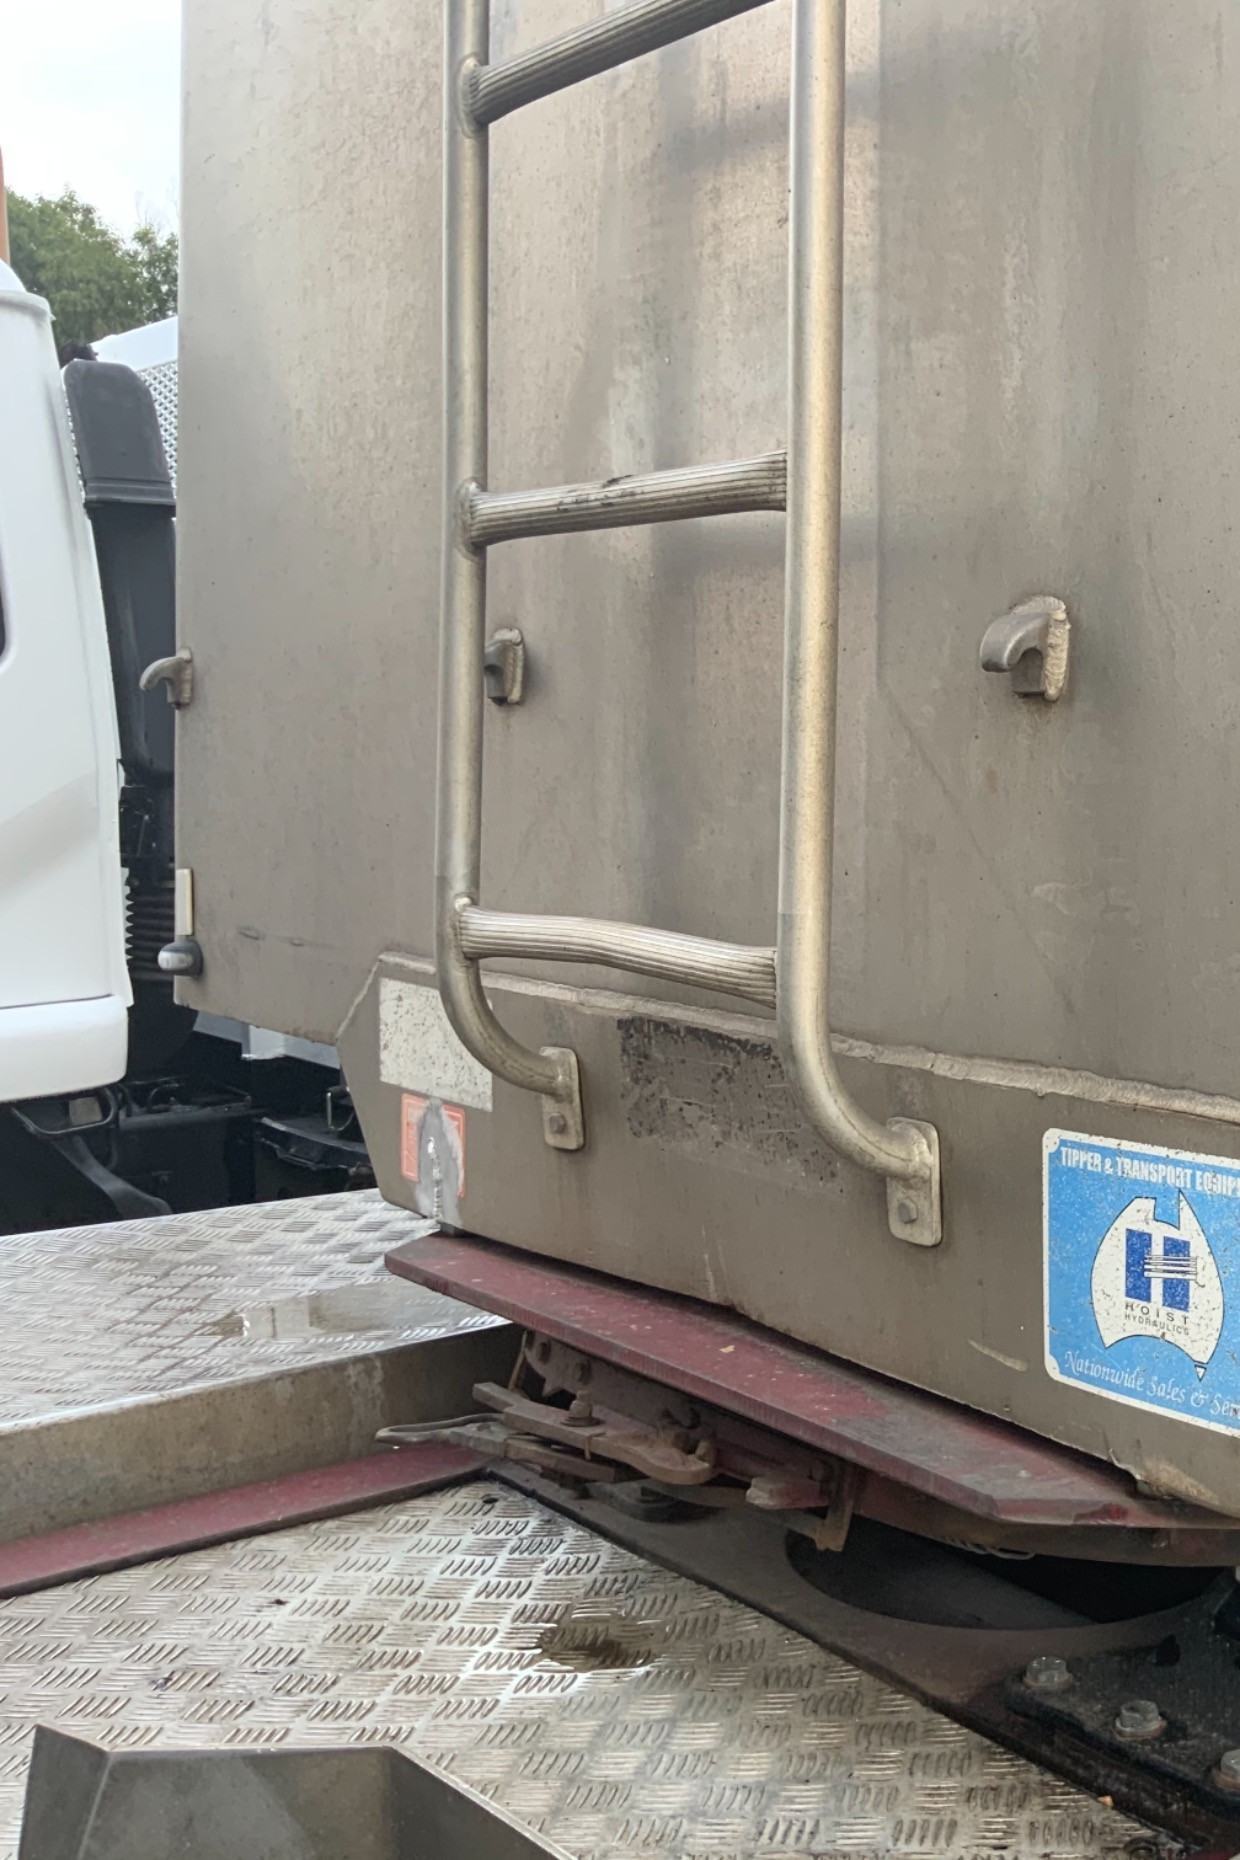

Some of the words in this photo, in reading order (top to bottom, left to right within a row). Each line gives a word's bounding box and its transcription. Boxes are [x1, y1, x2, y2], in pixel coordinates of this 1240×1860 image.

[1060, 1146, 1101, 1172] TIPPER
[1103, 1157, 1114, 1175] &
[1115, 1156, 1193, 1190] TRANSPORT
[1124, 1302, 1188, 1325] HOIST
[1124, 1311, 1190, 1336] HYDRAULICS
[1064, 1350, 1144, 1391] Nationwide
[1146, 1376, 1186, 1403] Sales
[1190, 1389, 1209, 1407] &
